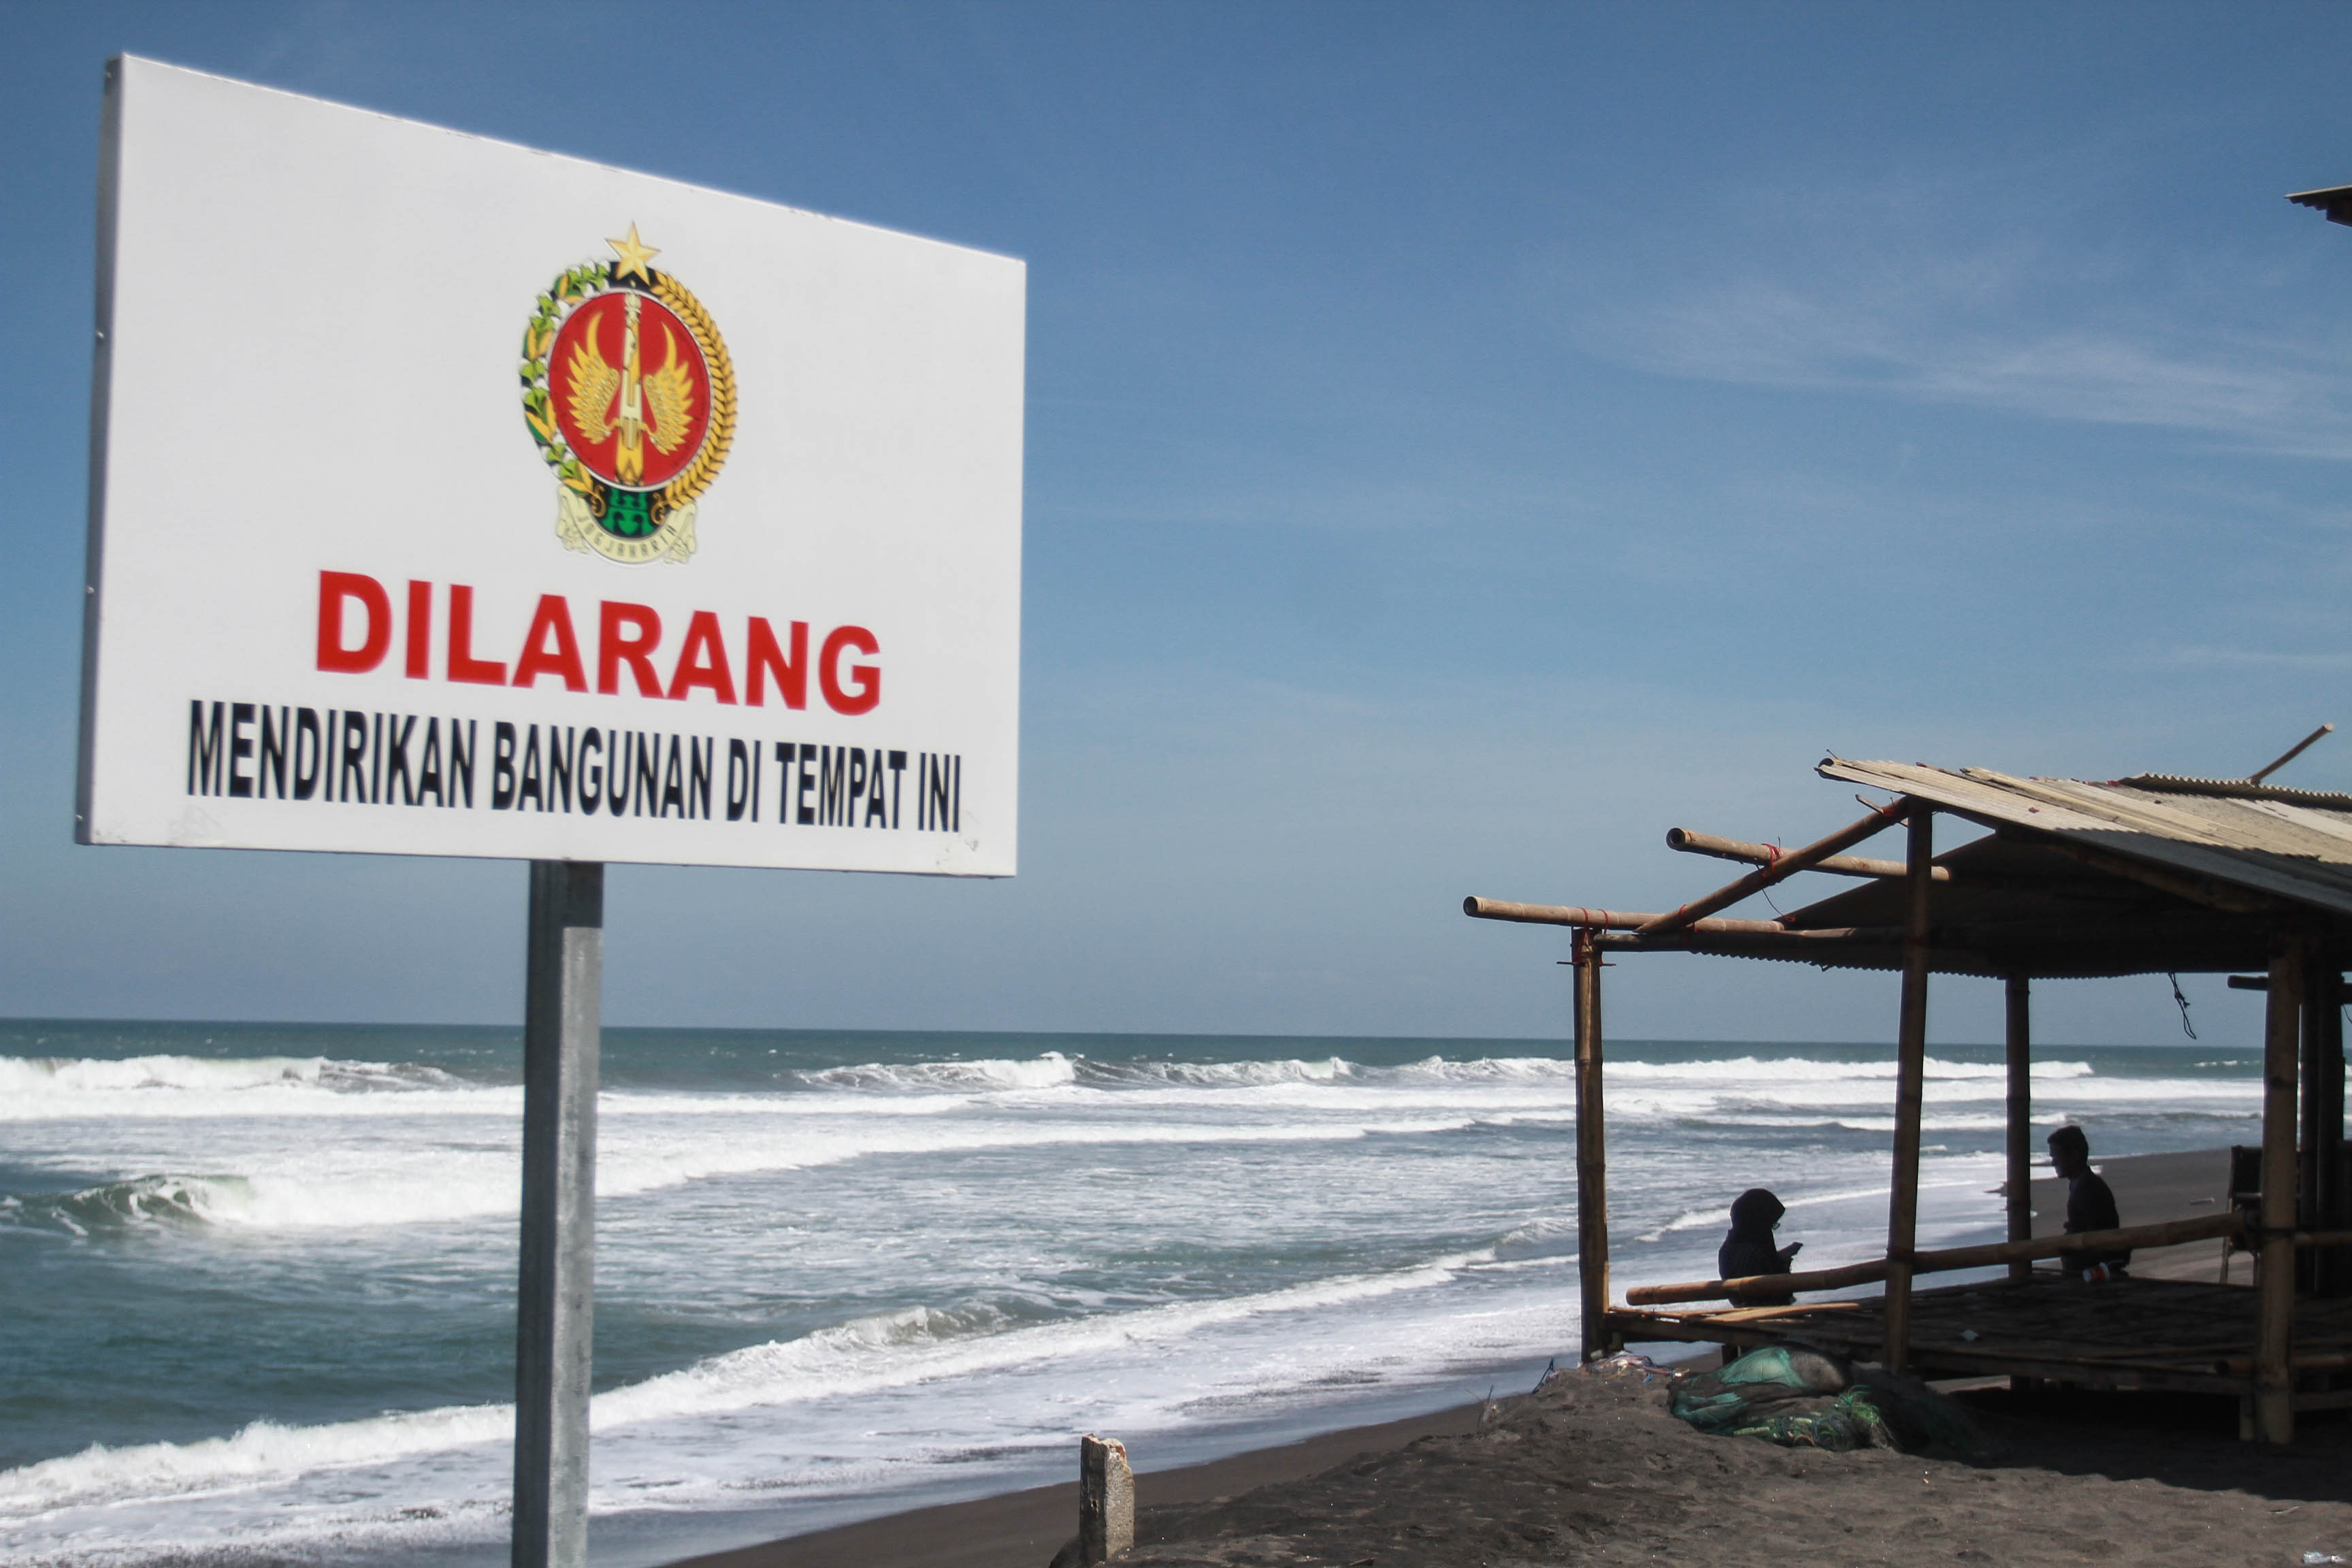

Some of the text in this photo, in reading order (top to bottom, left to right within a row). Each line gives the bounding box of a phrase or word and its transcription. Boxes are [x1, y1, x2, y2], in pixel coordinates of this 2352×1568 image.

[316, 570, 881, 716] DILARANG
[188, 700, 960, 832] MENDIRIKAN BANGUNAN DI TEMPAT INI
